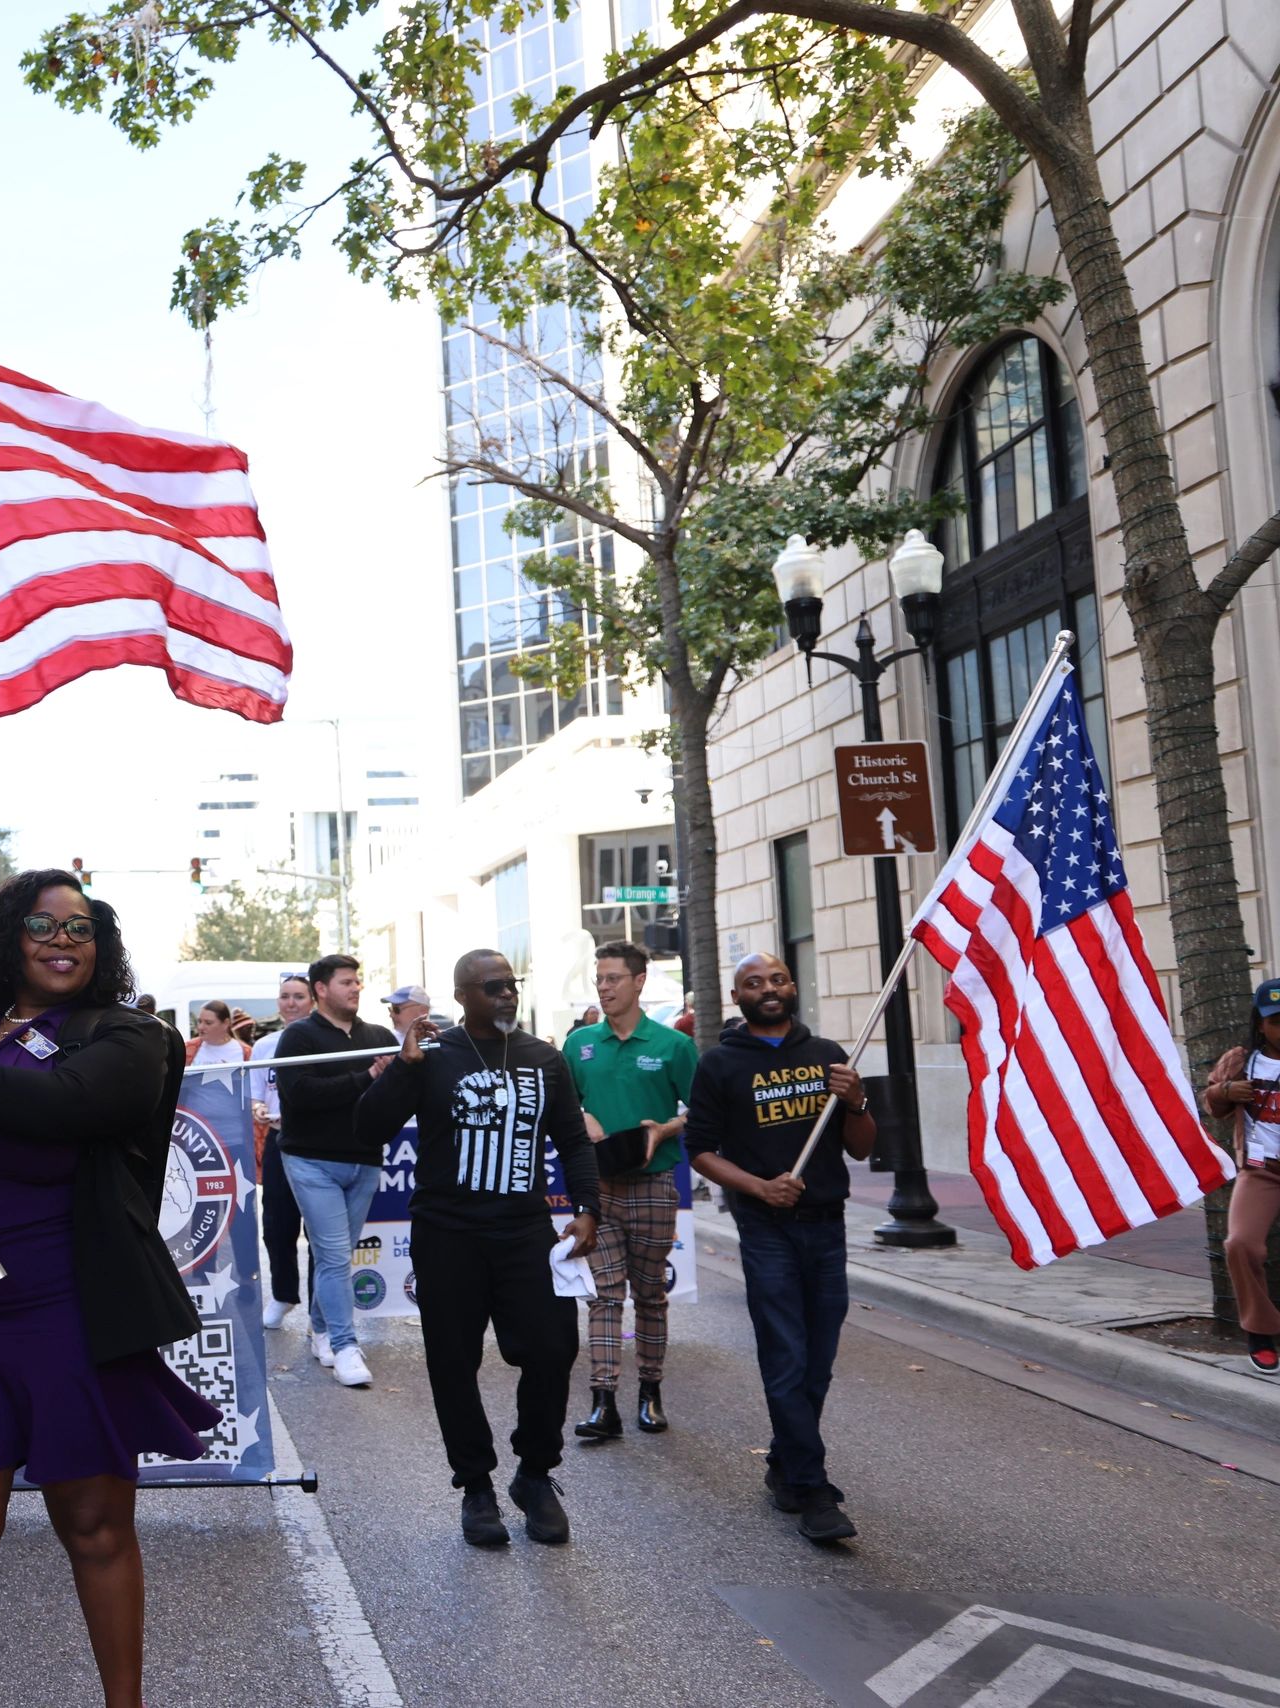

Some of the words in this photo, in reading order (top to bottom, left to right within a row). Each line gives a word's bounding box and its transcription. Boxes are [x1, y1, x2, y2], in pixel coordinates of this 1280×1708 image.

[853, 754, 908, 768] Historic
[847, 771, 900, 786] Church
[902, 770, 918, 783] St
[625, 888, 656, 901] Orange
[517, 1076, 536, 1116] HAVE
[754, 1081, 826, 1102] EMMANUEL
[756, 1094, 829, 1123] LEWIS
[515, 1121, 533, 1132] A
[170, 1119, 216, 1164] UNTY
[511, 1138, 531, 1193] DREAM
[205, 1181, 224, 1190] 1983
[184, 1208, 216, 1251] CAUCUS
